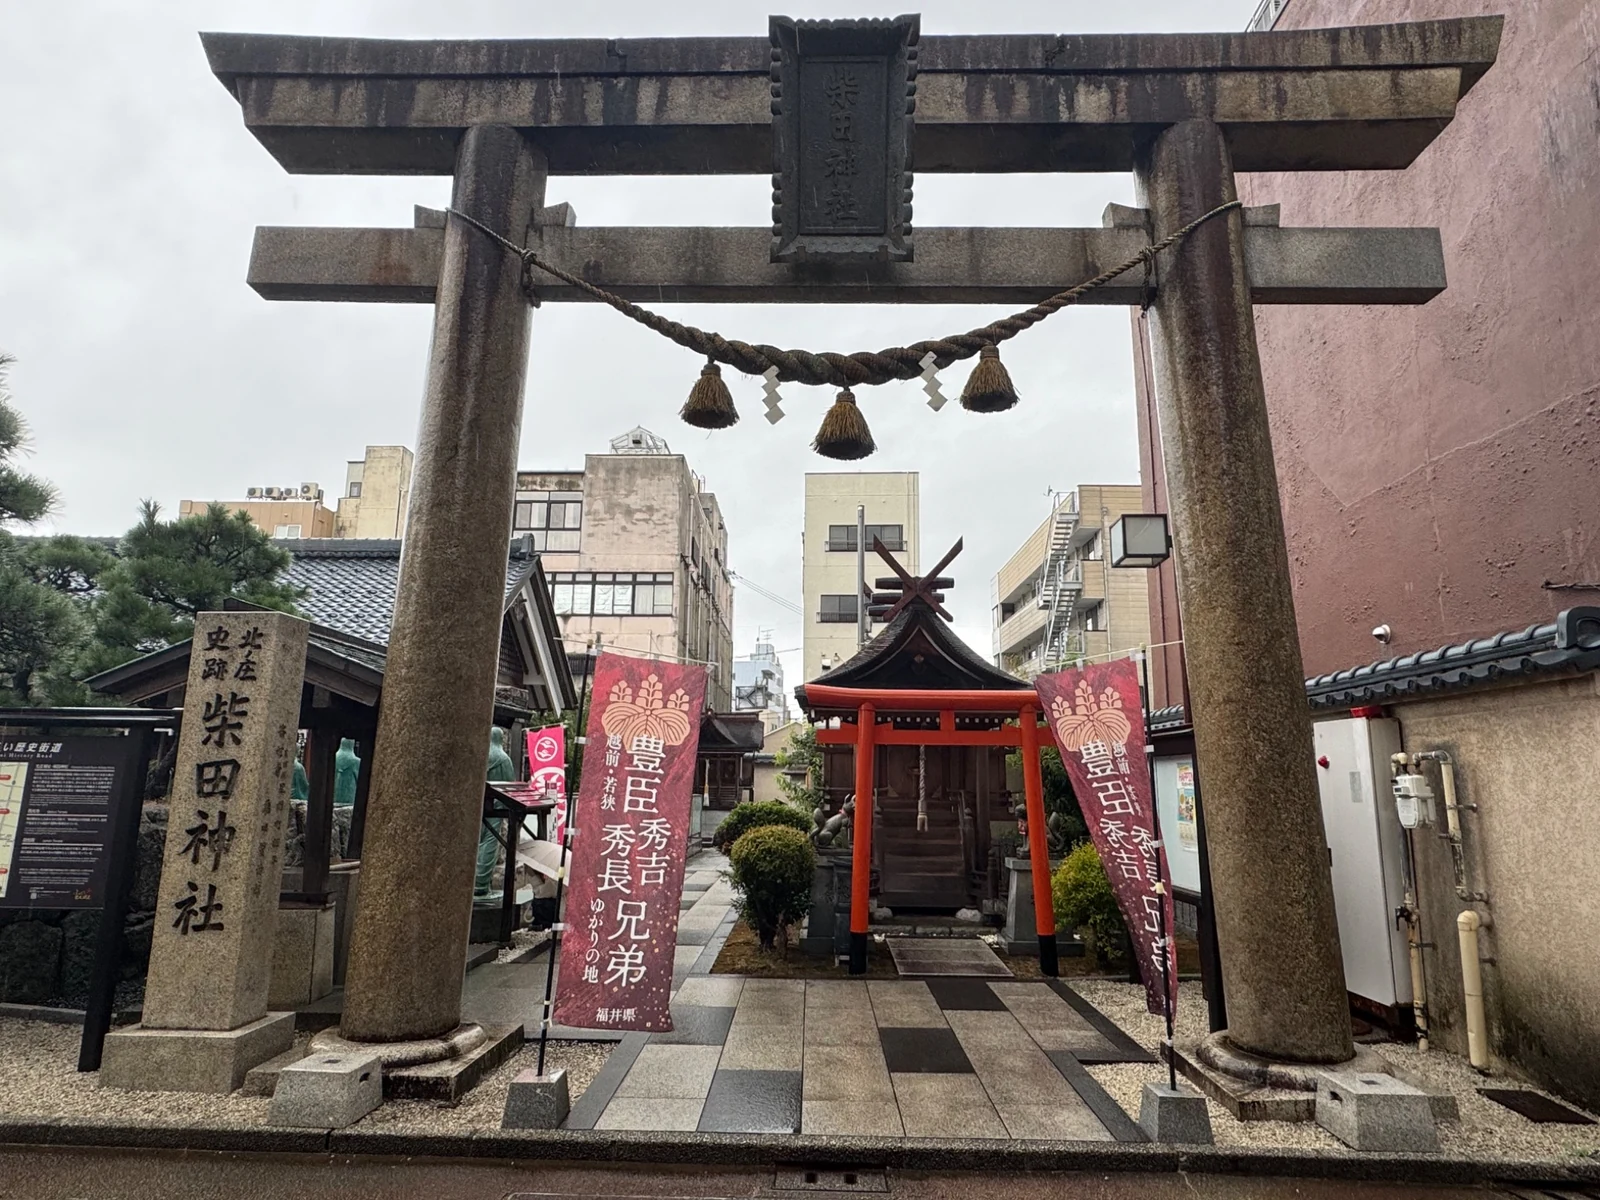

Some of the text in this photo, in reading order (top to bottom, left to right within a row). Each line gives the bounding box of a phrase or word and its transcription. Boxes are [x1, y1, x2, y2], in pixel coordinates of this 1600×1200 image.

[824, 67, 860, 222] 柴田神社
[202, 625, 231, 681] 史跡
[234, 626, 264, 681] 北ノ庄
[0, 741, 63, 753] い歴史街道
[600, 734, 623, 812] 越前・若狭
[172, 691, 250, 936] 柴田神社
[623, 733, 672, 886] 豊臣 秀吉
[596, 823, 637, 895] 秀長
[581, 896, 606, 984] ゆかりの地
[603, 898, 651, 988] 兄弟
[595, 1006, 637, 1022] 福井県
